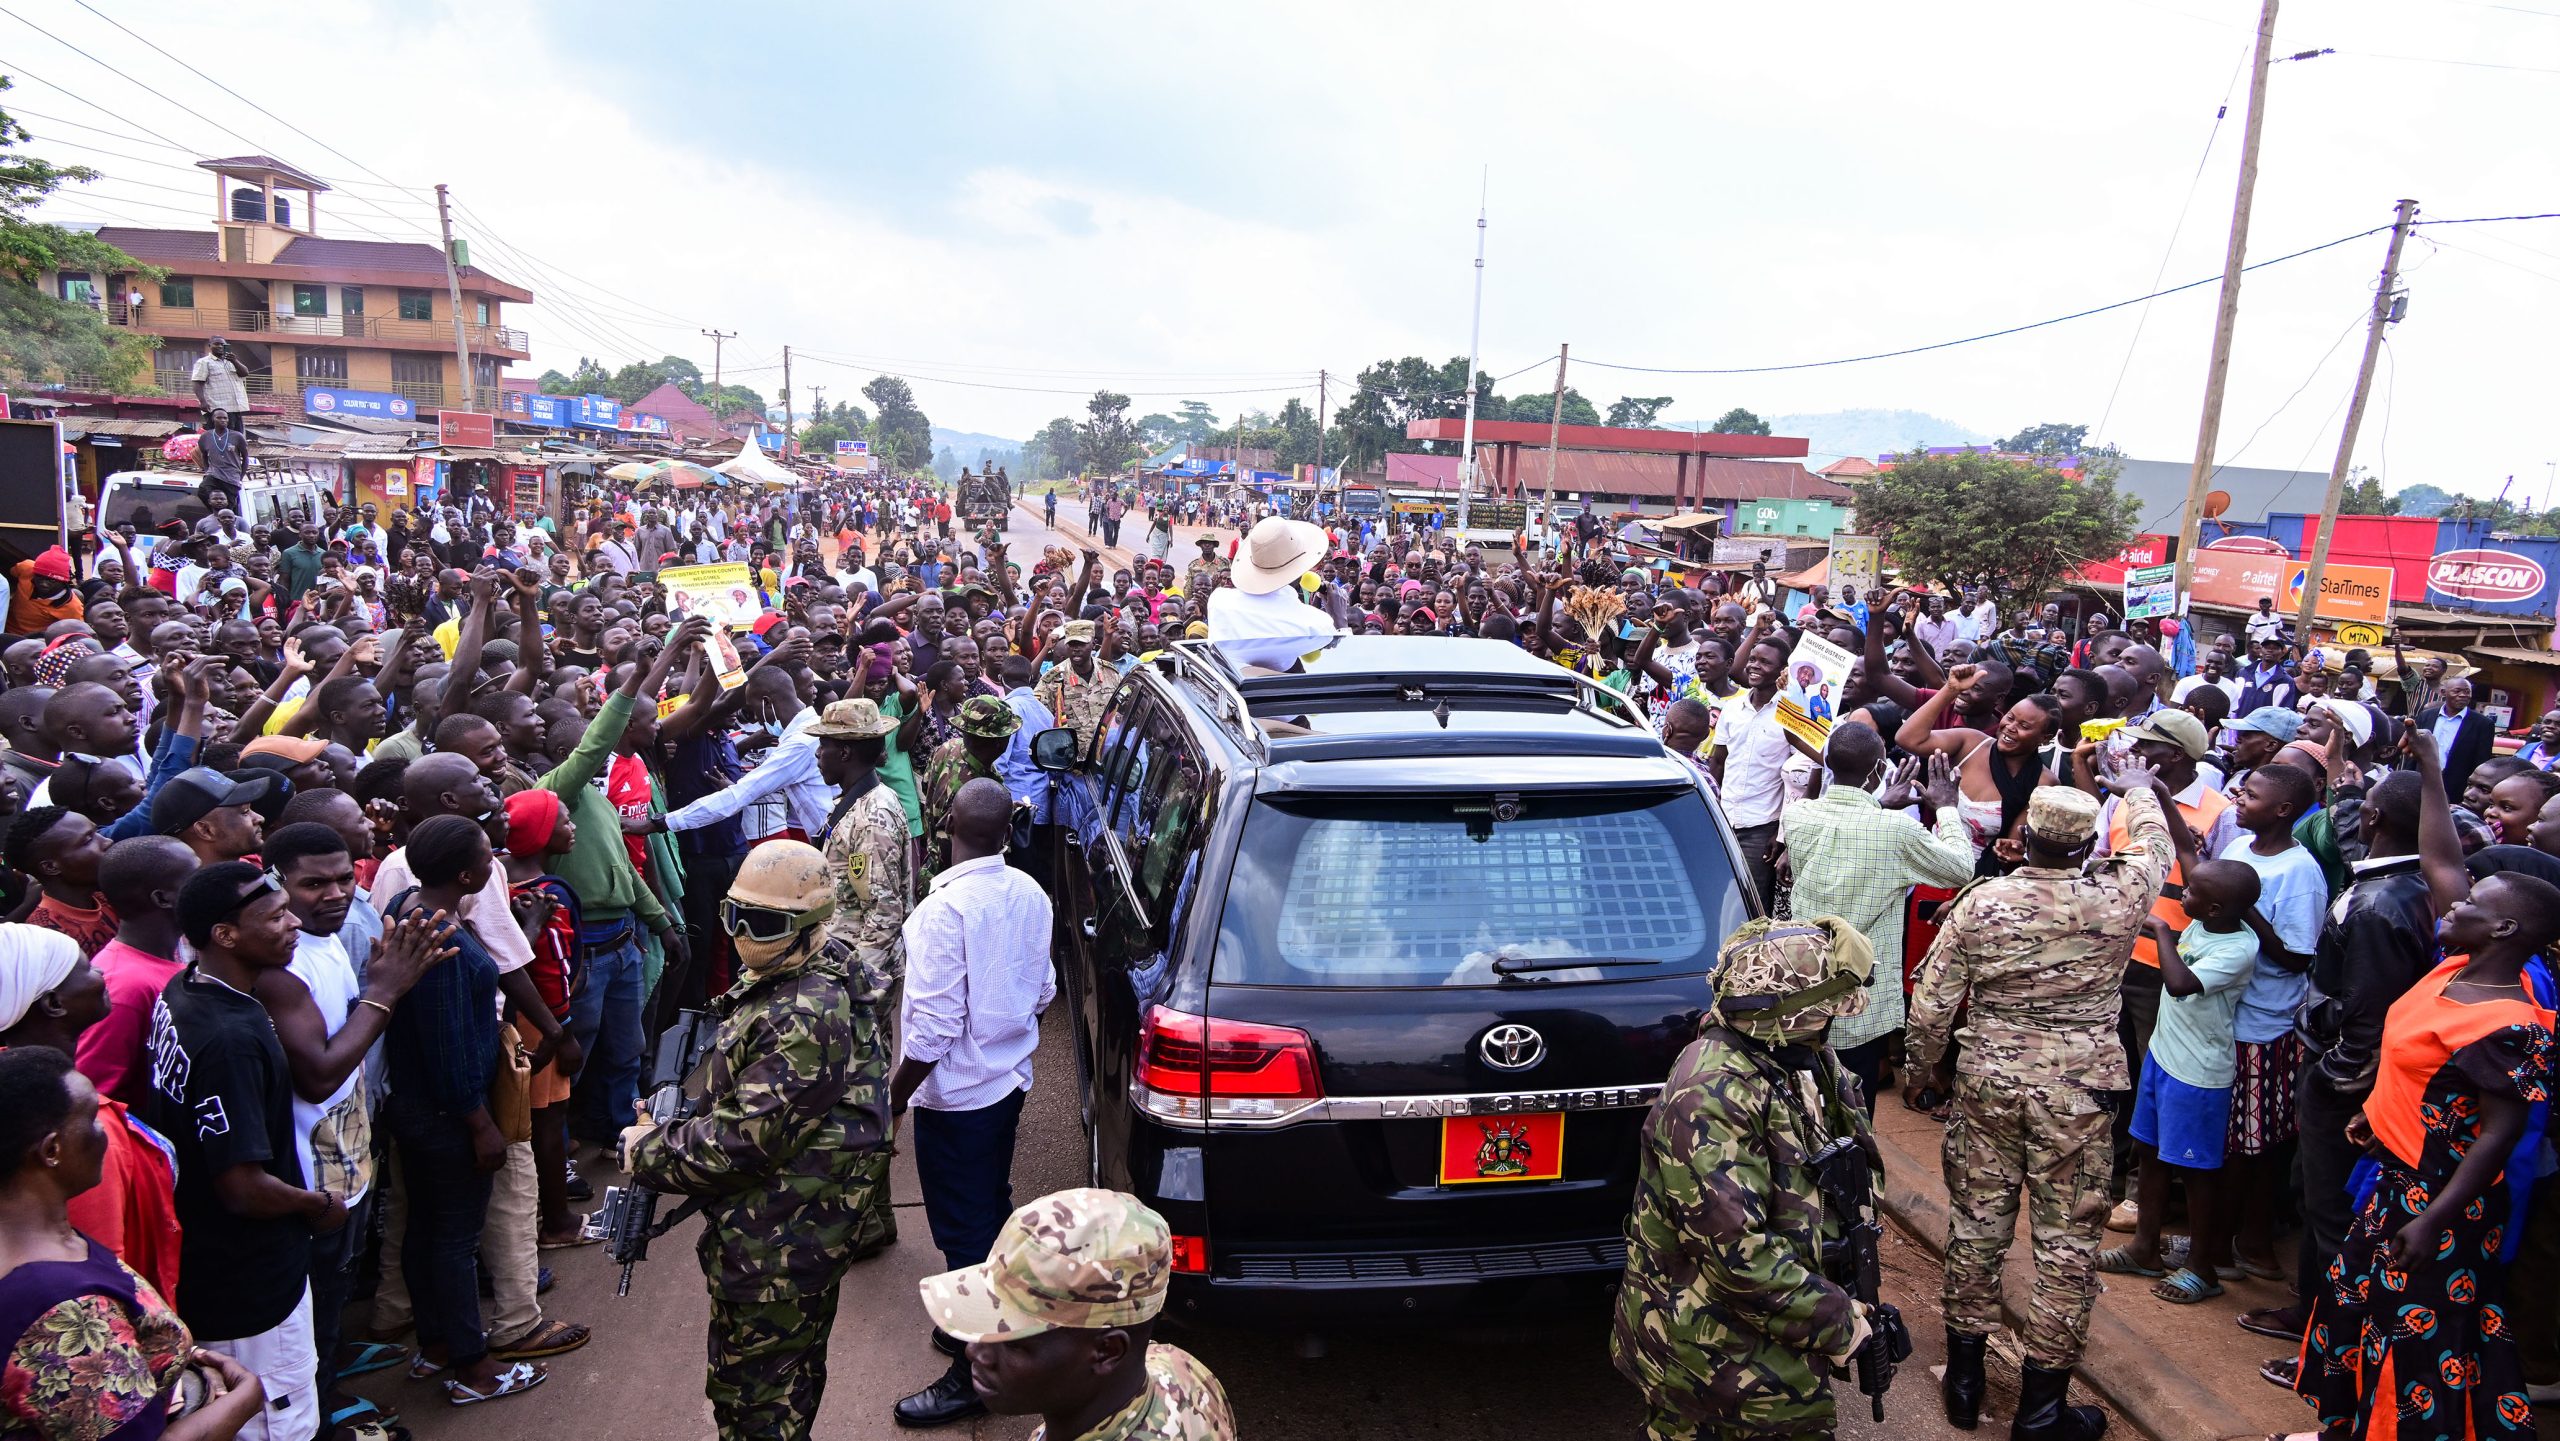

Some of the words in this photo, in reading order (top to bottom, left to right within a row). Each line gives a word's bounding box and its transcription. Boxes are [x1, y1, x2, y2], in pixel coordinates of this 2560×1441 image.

[2128, 549, 2153, 563] airtel
[2251, 570, 2277, 586] airtel
[2435, 564, 2532, 588] PLASCON
[2320, 577, 2380, 598] StarTimes
[2348, 632, 2370, 643] MTN
[1806, 637, 1825, 651] MAYUGE
[1824, 647, 1846, 663] DISTRICT
[1380, 1098, 1471, 1118] LAND
[1494, 1088, 1642, 1112] CRUISER
